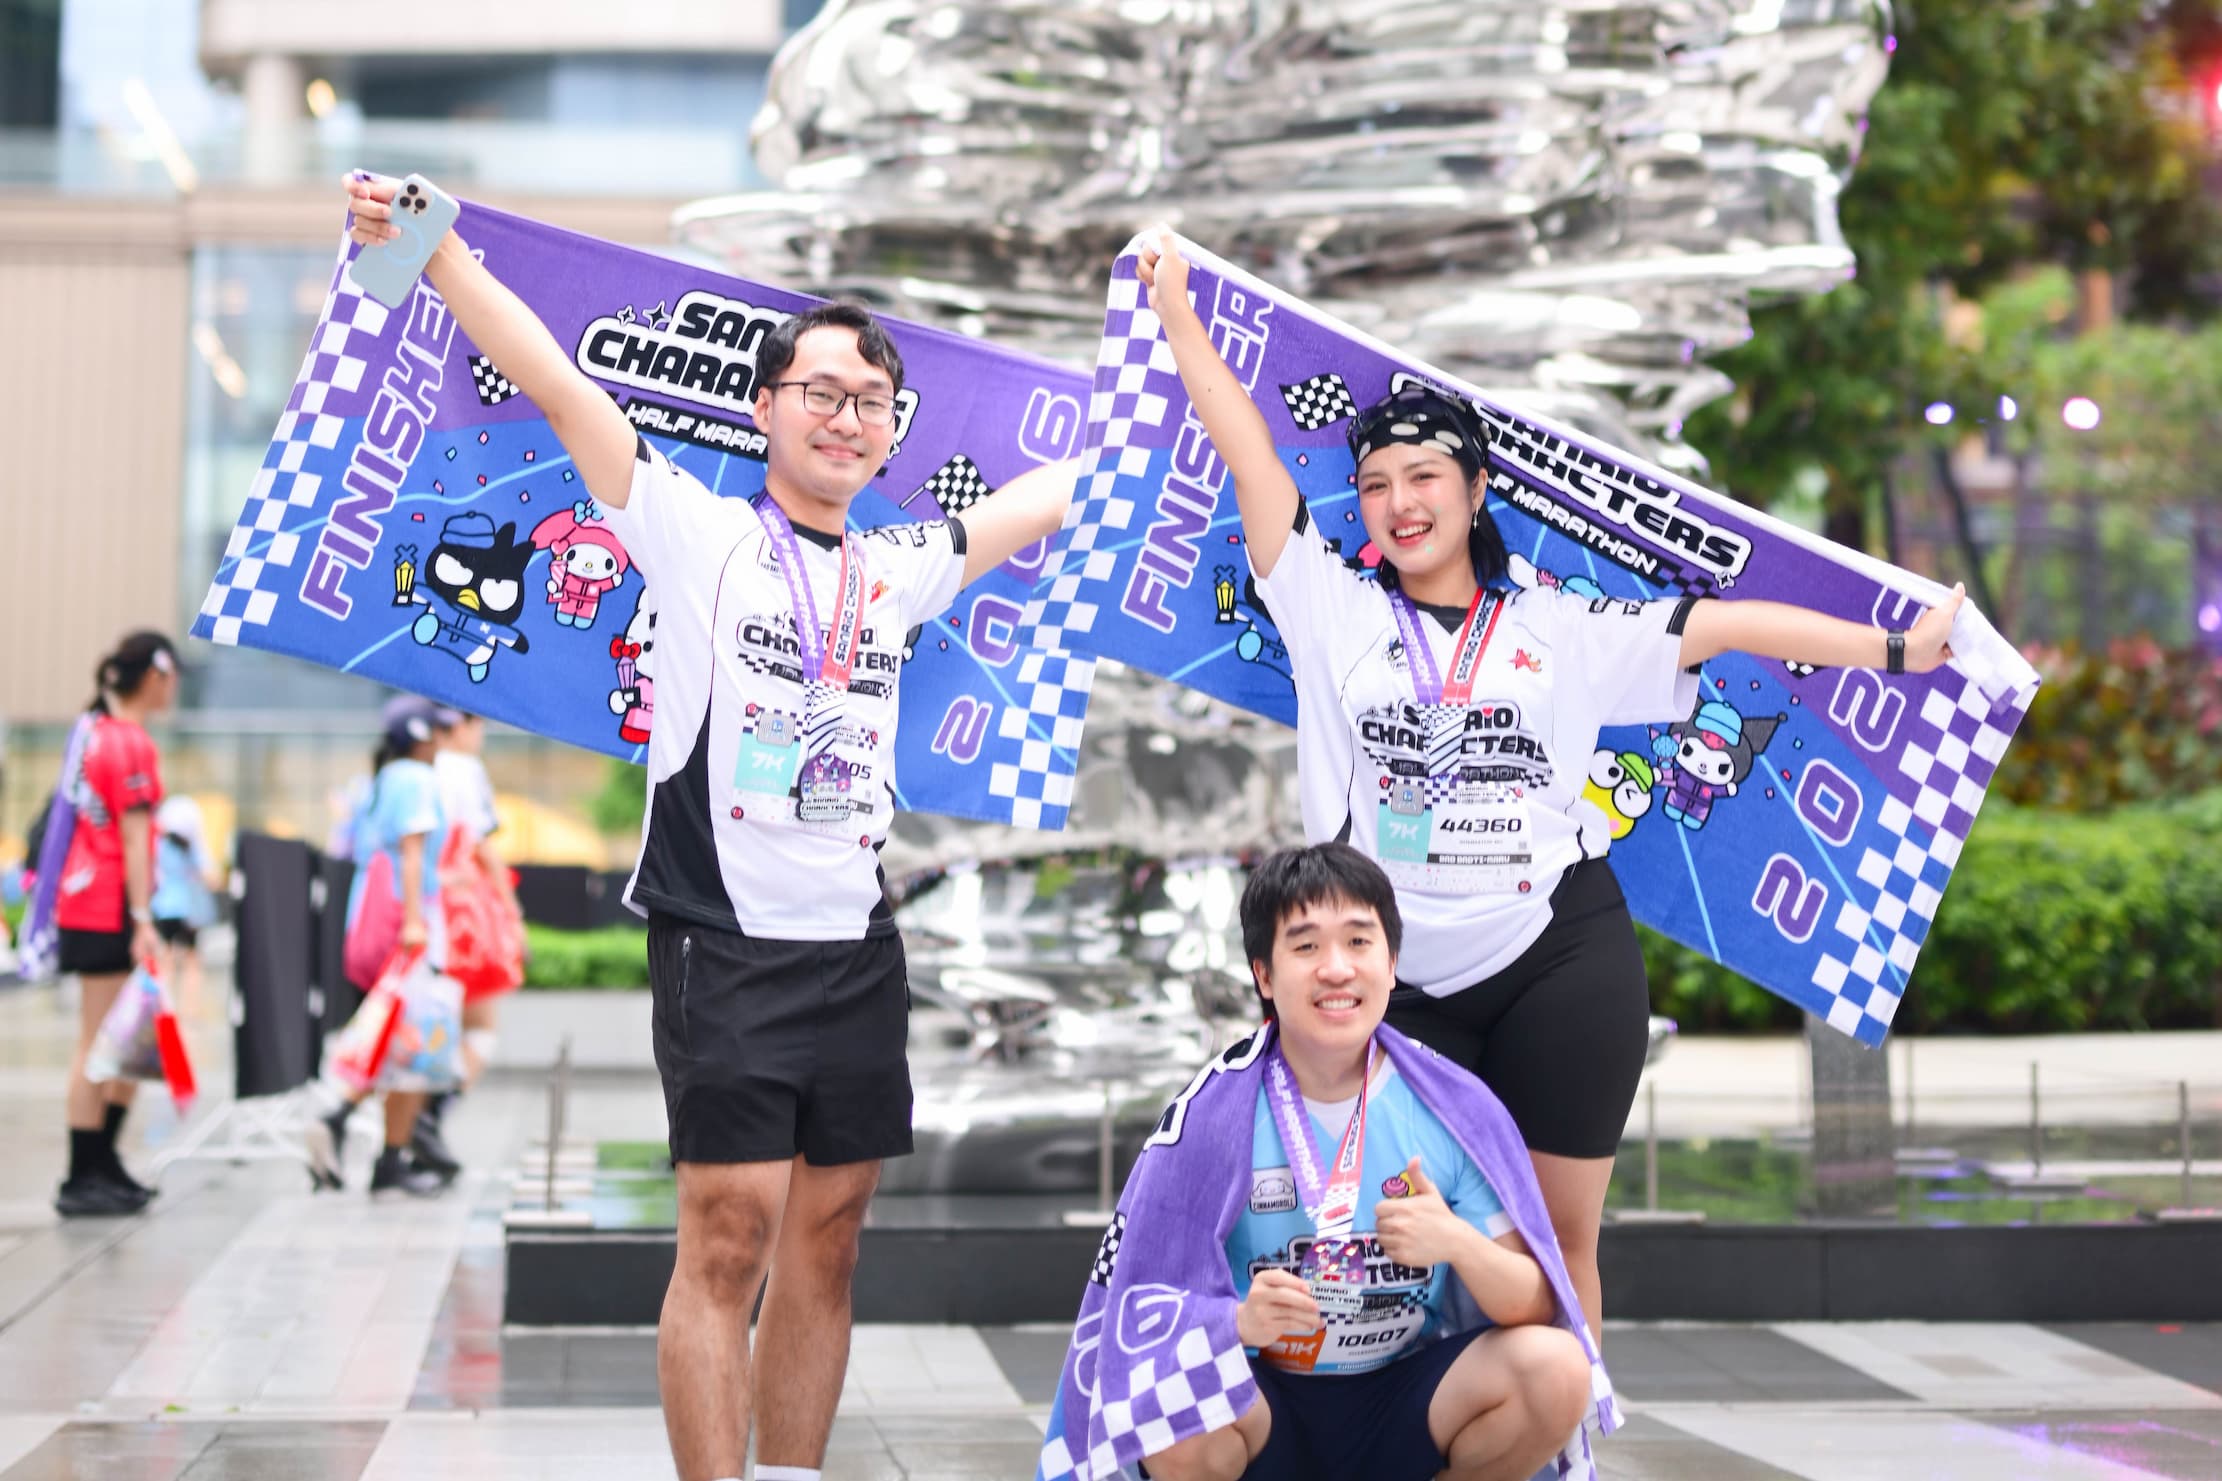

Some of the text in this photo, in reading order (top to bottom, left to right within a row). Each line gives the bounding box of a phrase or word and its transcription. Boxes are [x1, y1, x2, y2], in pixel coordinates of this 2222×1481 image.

[676, 301, 767, 355] SAN
[299, 249, 484, 621] FINISHE
[624, 402, 767, 454] HALF MARA
[1120, 277, 1275, 634] FINISER
[1487, 421, 1741, 569] ARACTERS
[1512, 484, 1659, 575] MARATHON
[834, 610, 854, 661] SANRIO
[1440, 818, 1522, 833] 44360
[1338, 1327, 1409, 1348] 10607
